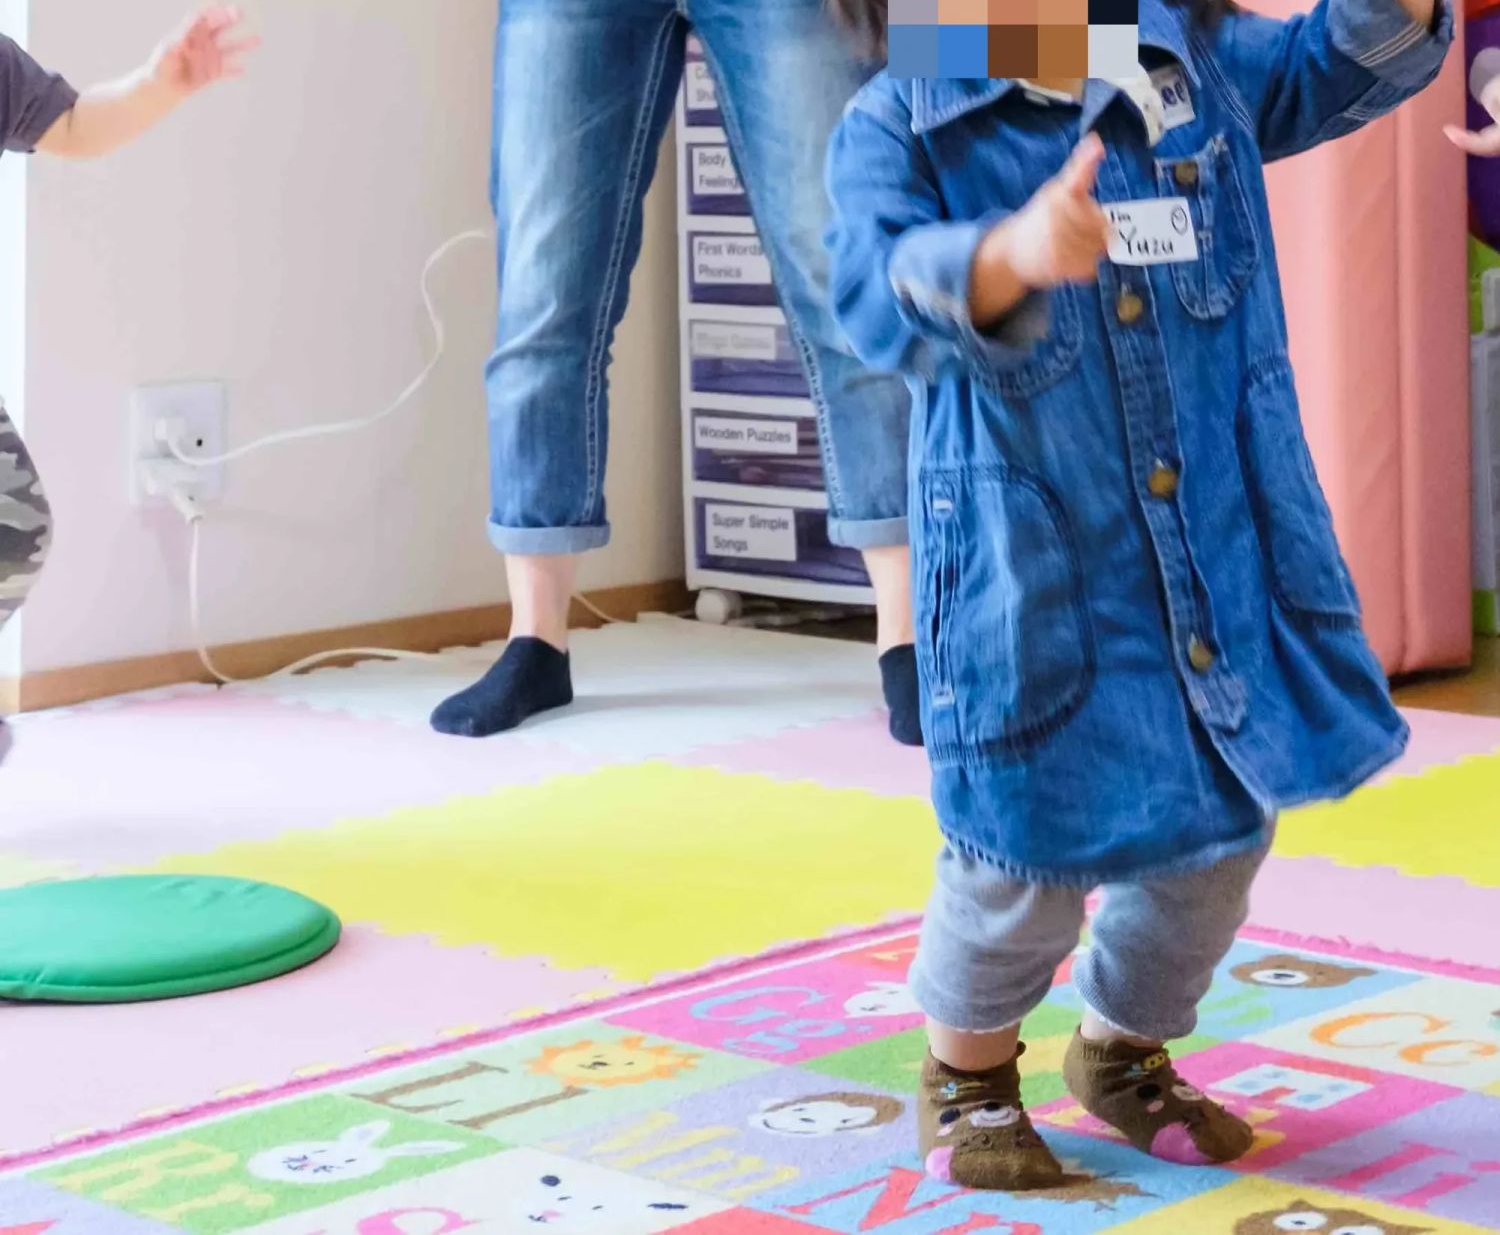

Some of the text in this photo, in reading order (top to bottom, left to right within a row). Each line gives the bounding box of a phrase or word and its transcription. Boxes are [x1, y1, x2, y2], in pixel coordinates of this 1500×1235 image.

[699, 152, 727, 168] Body
[698, 241, 763, 257] First Words
[1118, 226, 1175, 256] Yuzu
[698, 264, 742, 279] Phonics
[699, 426, 792, 444] Wooden Puzzles
[712, 511, 789, 533] Super Simple
[712, 535, 749, 552] Songs
[1309, 1011, 1500, 1066] Cc
